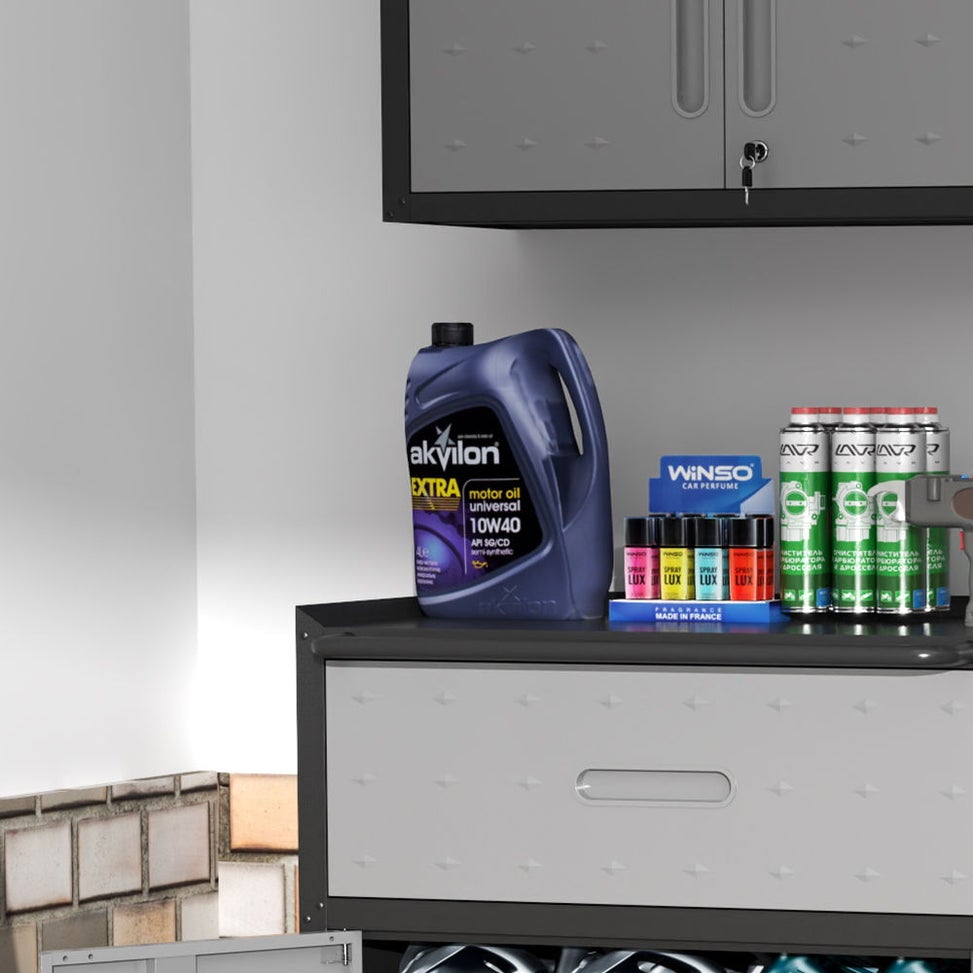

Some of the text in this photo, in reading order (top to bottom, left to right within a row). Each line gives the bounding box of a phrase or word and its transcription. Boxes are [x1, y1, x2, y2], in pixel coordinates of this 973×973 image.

[410, 440, 499, 472] akvilon
[411, 477, 461, 497] EXTRA
[682, 482, 739, 490] CAR PERFUME
[469, 487, 520, 499] motor oil
[469, 500, 521, 512] universal
[470, 517, 521, 534] 10W40
[471, 538, 510, 547] API SG/CD
[628, 574, 645, 585] LUX
[664, 574, 681, 585] LUX
[700, 575, 717, 586] LUX
[735, 575, 753, 586] LUX
